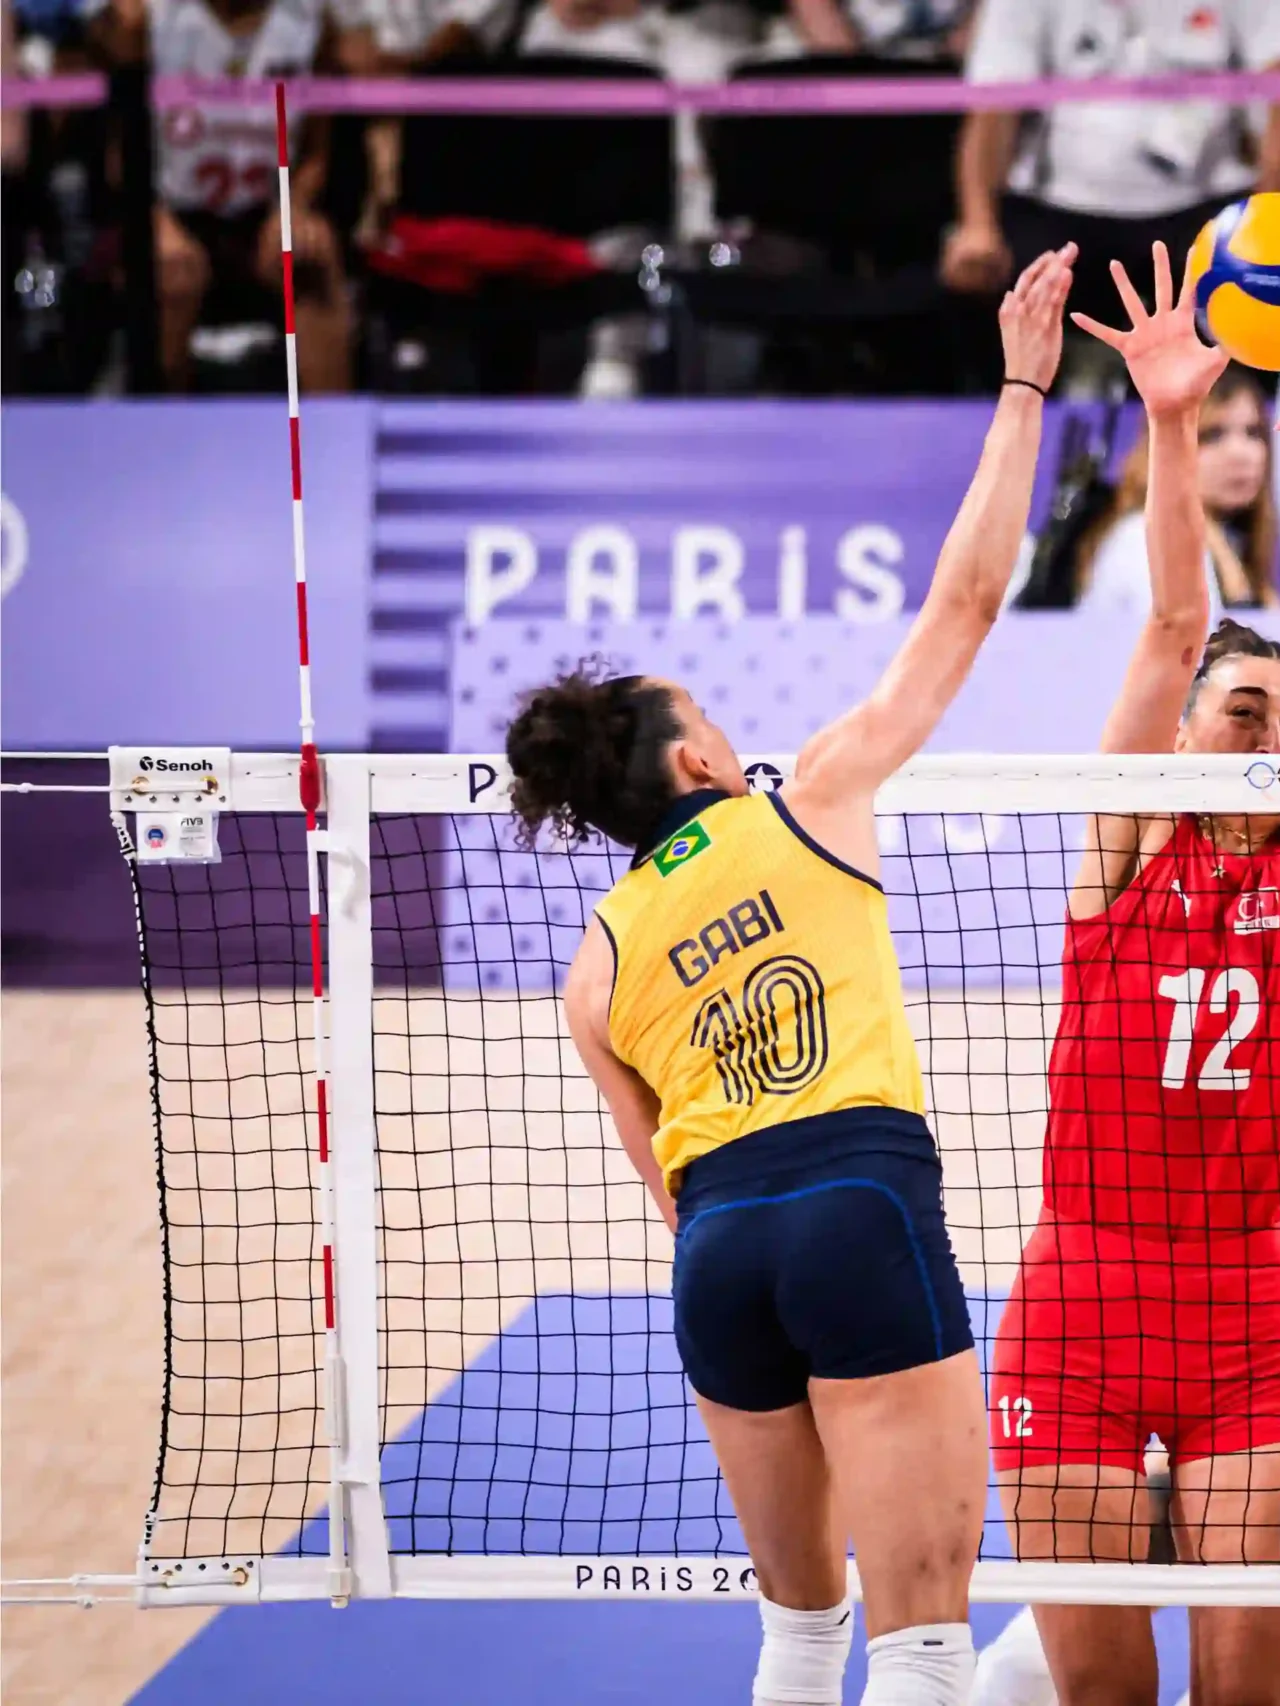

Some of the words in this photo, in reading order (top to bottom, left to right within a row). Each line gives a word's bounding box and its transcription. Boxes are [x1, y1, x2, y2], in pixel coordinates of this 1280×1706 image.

[156, 759, 213, 771] Senoh
[668, 889, 785, 987] GABI
[690, 955, 828, 1106] 10
[1158, 967, 1260, 1090] 12
[997, 1395, 1033, 1438] 12
